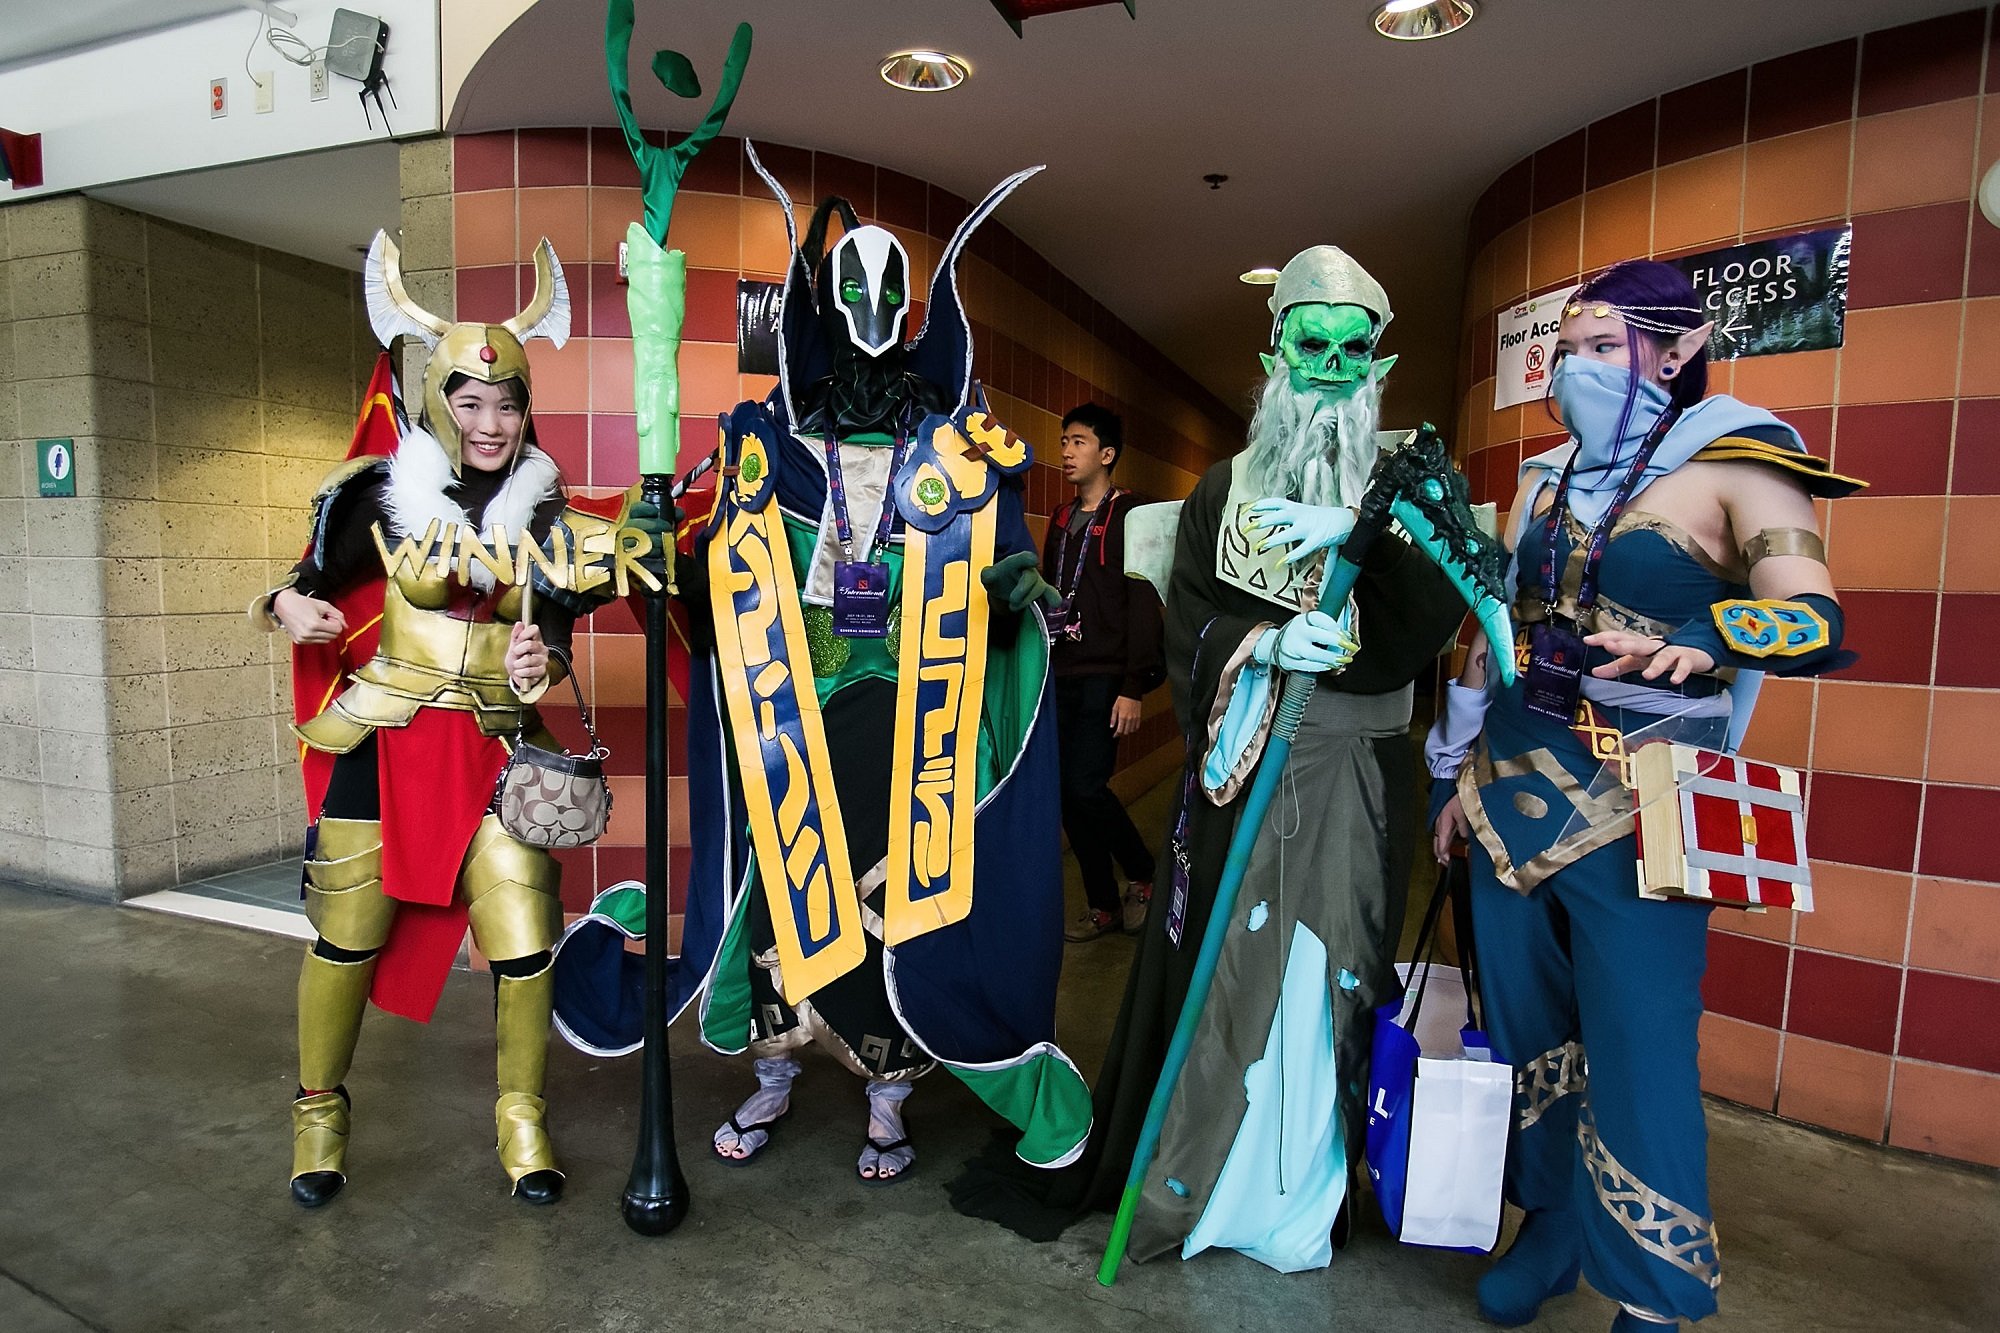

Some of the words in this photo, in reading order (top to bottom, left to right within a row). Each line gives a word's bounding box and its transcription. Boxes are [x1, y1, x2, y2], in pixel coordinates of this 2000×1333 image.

[1692, 254, 1792, 289] FLOOR
[1705, 278, 1797, 311] CCESS
[1500, 329, 1527, 351] Floor
[1530, 320, 1560, 340] Acc
[370, 517, 680, 598] WINNER!
[843, 587, 886, 597] International
[1538, 657, 1580, 676] International
